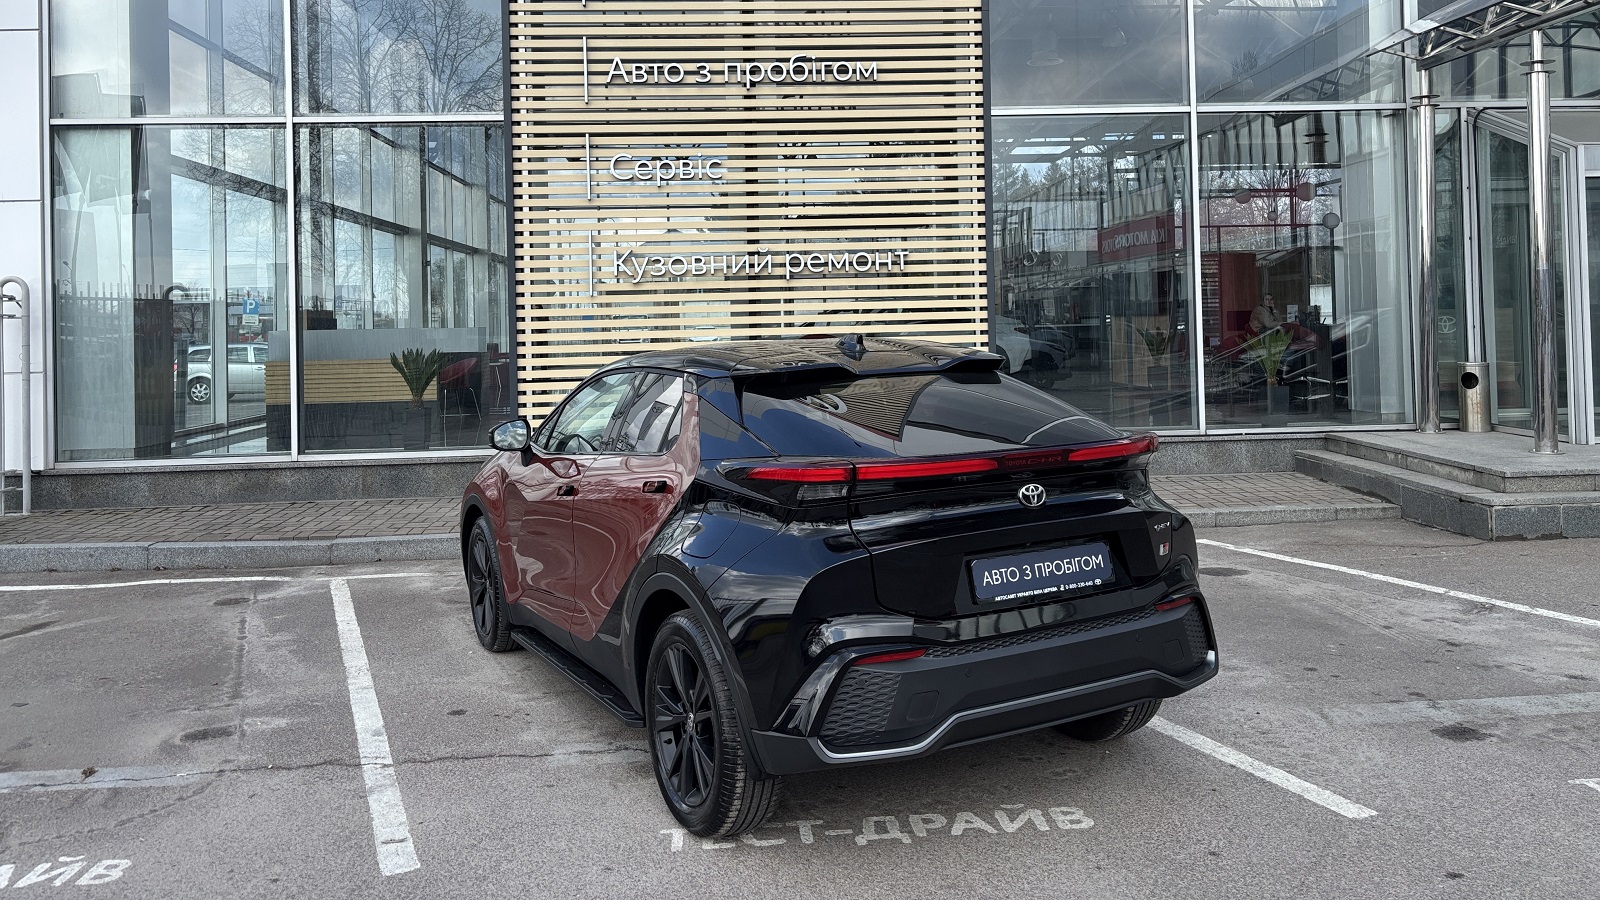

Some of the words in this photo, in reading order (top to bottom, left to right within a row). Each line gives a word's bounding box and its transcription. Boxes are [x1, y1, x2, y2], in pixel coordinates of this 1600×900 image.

[606, 56, 685, 84] Авто
[694, 63, 712, 83] з
[723, 53, 879, 91] пробігом
[609, 153, 723, 187] Сервіс
[612, 247, 773, 284] Кузовний
[785, 249, 909, 280] ремонт
[246, 299, 256, 314] P
[983, 567, 1020, 586] АВТО
[1034, 554, 1104, 579] ПРОБІГОМ
